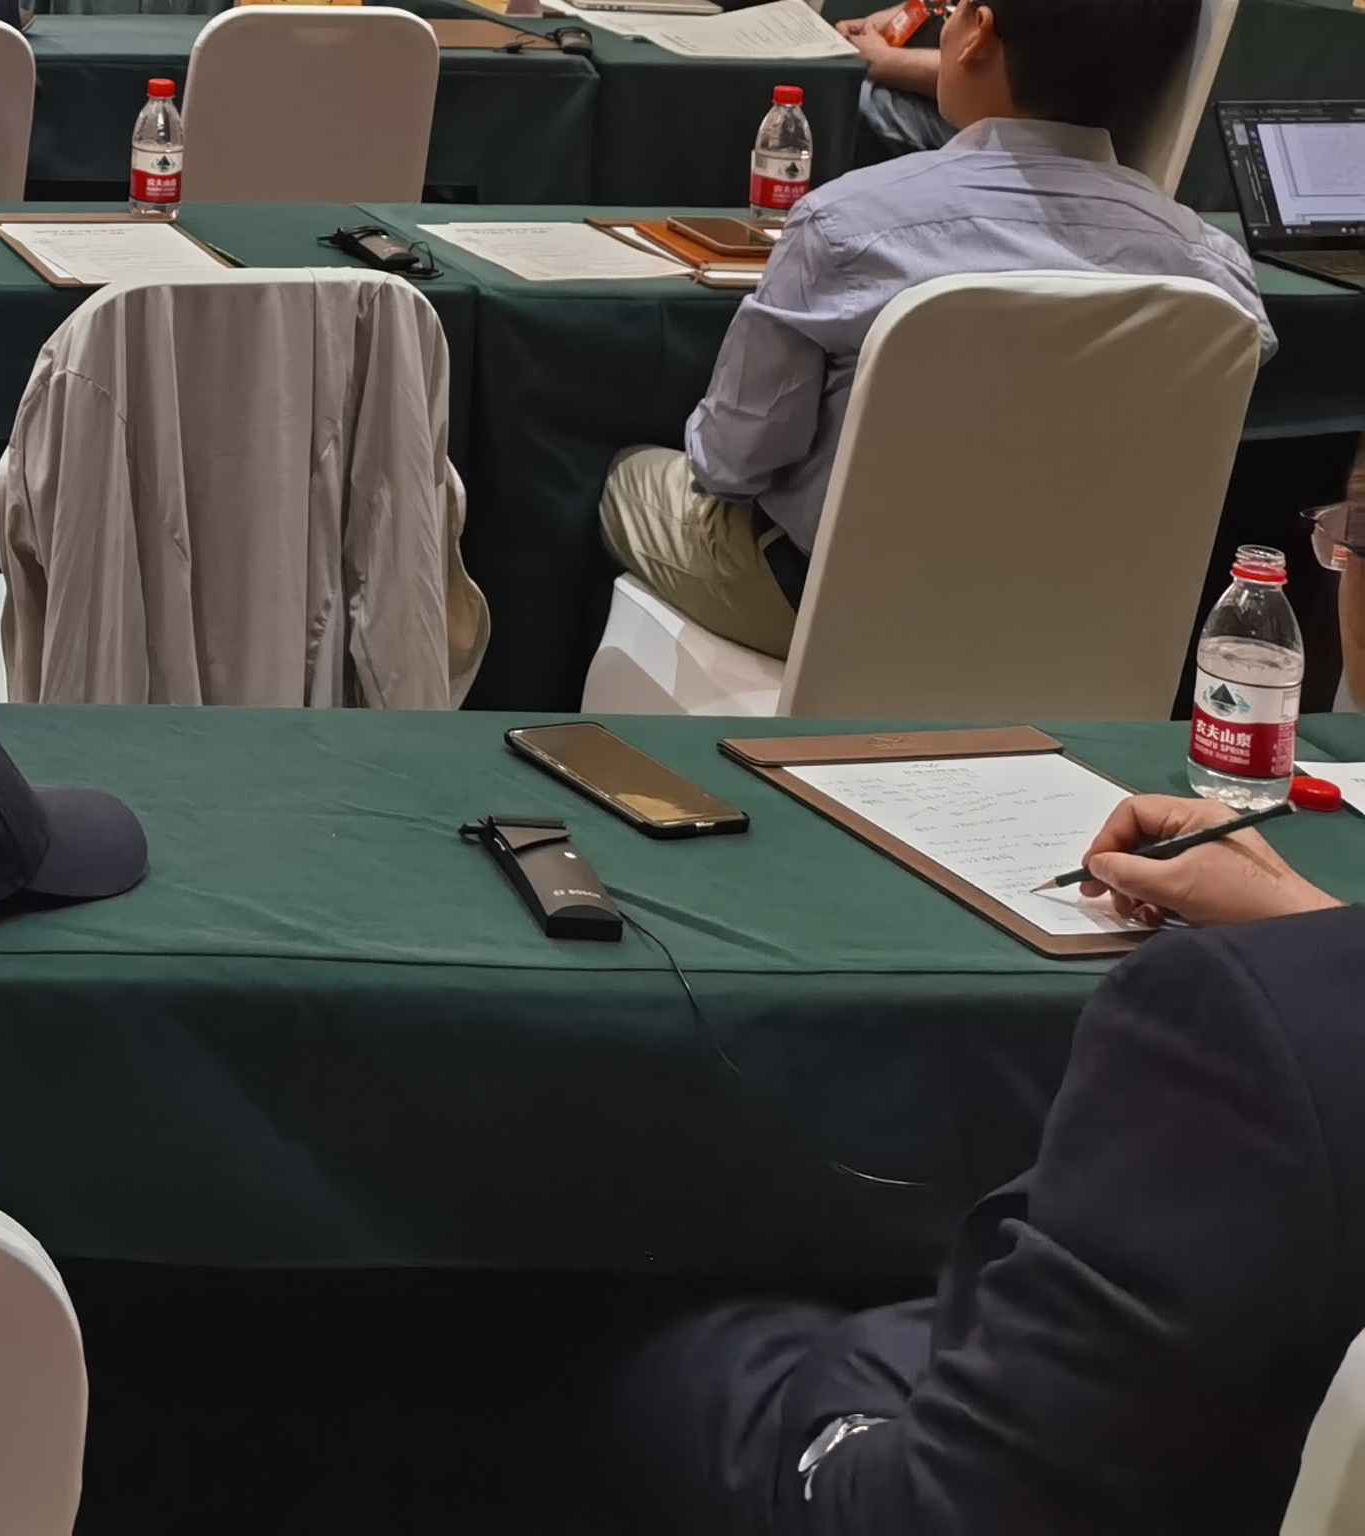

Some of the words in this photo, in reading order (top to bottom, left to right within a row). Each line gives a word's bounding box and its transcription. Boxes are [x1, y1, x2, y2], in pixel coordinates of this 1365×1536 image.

[1196, 718, 1252, 748] 农夫山泉
[1220, 743, 1251, 757] SPRING
